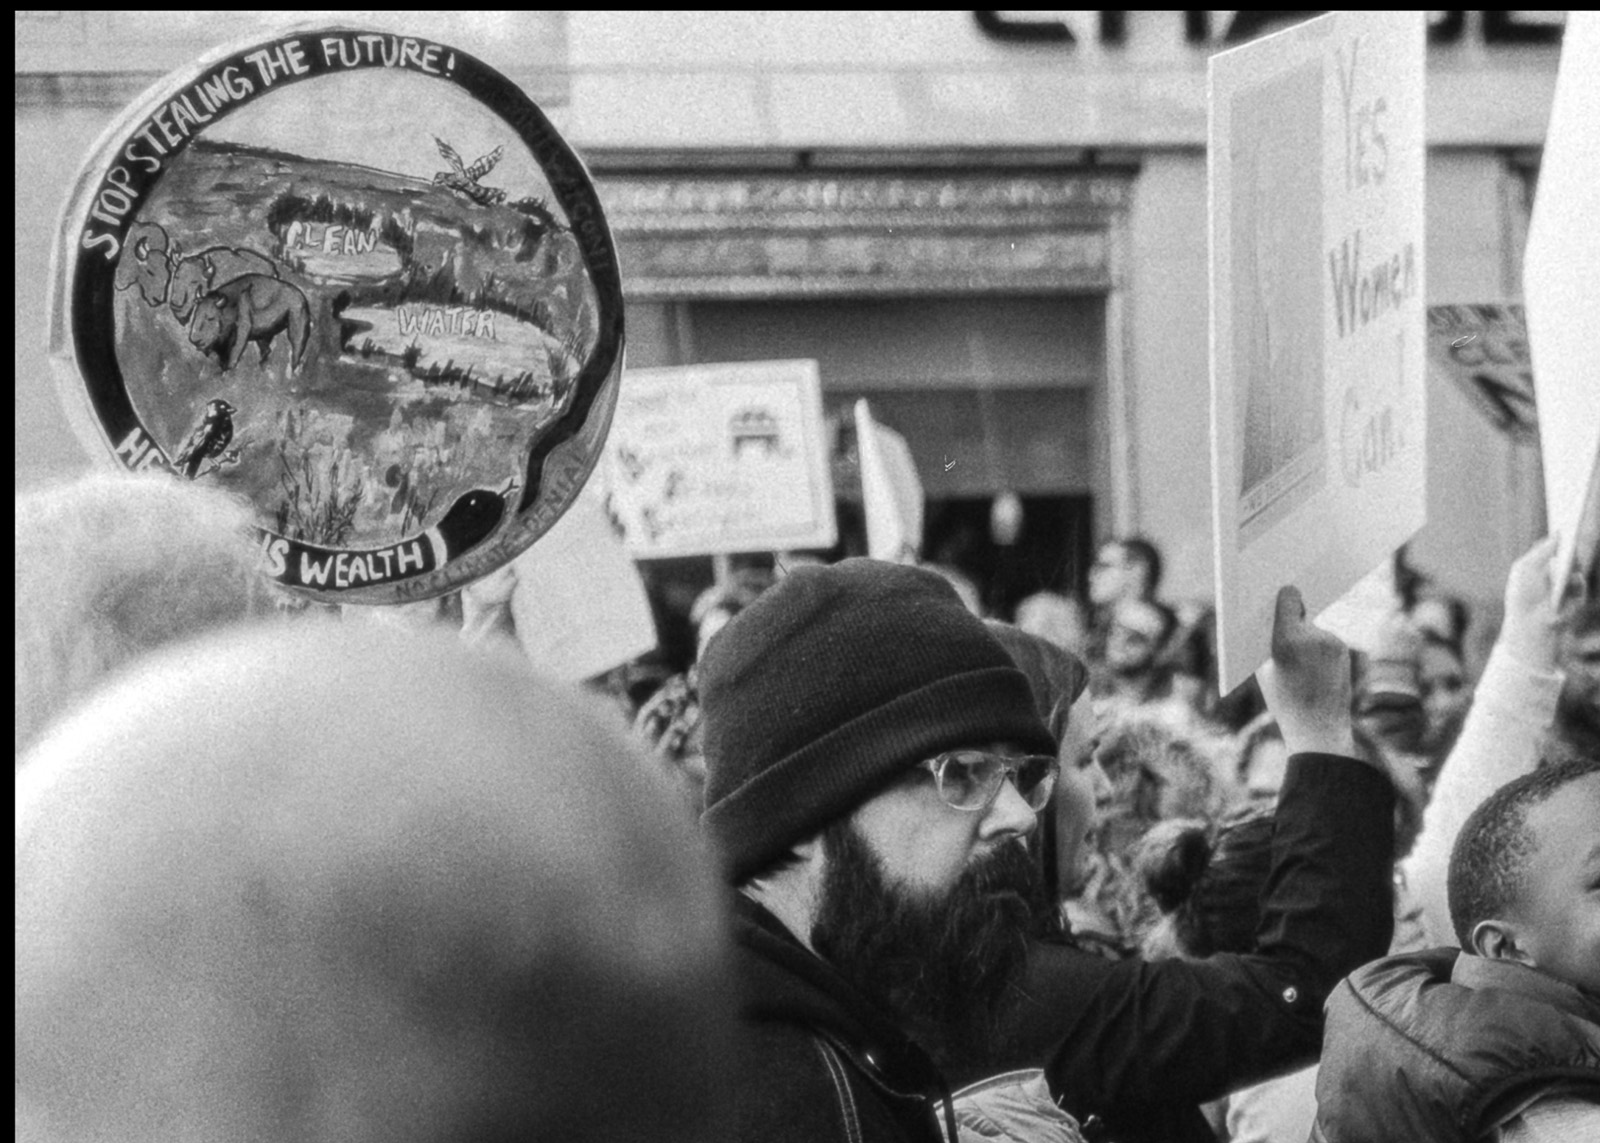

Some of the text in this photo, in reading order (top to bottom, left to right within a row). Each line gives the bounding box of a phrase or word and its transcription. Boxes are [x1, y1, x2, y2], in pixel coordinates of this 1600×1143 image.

[82, 35, 455, 260] STOP STEALING THE FUTURE!
[284, 220, 380, 254] CLEAN
[1328, 228, 1415, 339] Women
[398, 306, 498, 339] WATER
[301, 541, 424, 588] WEALTH
